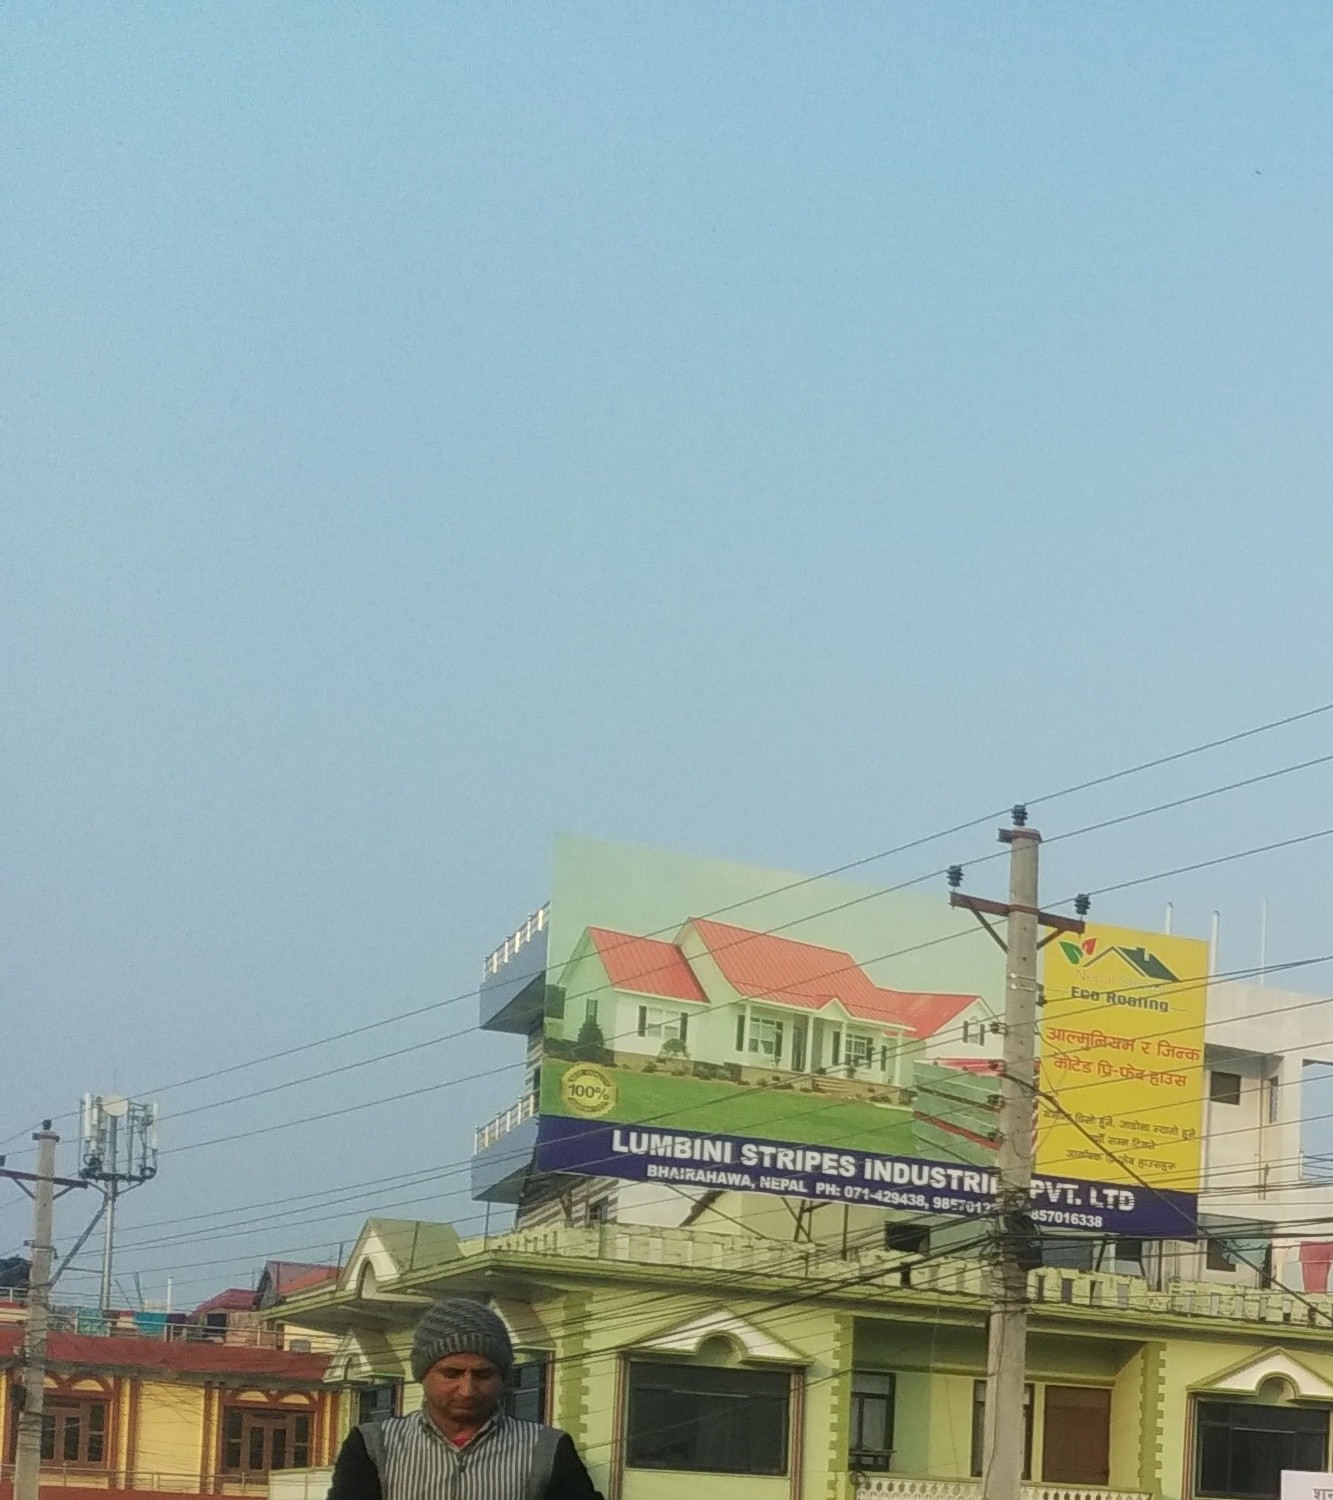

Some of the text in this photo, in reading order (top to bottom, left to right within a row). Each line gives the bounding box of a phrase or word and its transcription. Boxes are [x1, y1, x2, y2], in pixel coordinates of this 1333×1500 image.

[1071, 986, 1100, 1002] Eco
[567, 1084, 610, 1101] 100%
[612, 1129, 732, 1163] LUMBINI
[741, 1143, 856, 1176] STRIPES
[1029, 1180, 1081, 1206] PVT.
[1090, 1187, 1135, 1211] LTD
[647, 1164, 755, 1189] BHAIRAHAWA,
[760, 1176, 808, 1194] NEPAL
[815, 1182, 841, 1197] PH:
[1029, 1209, 1102, 1228] 857016338
